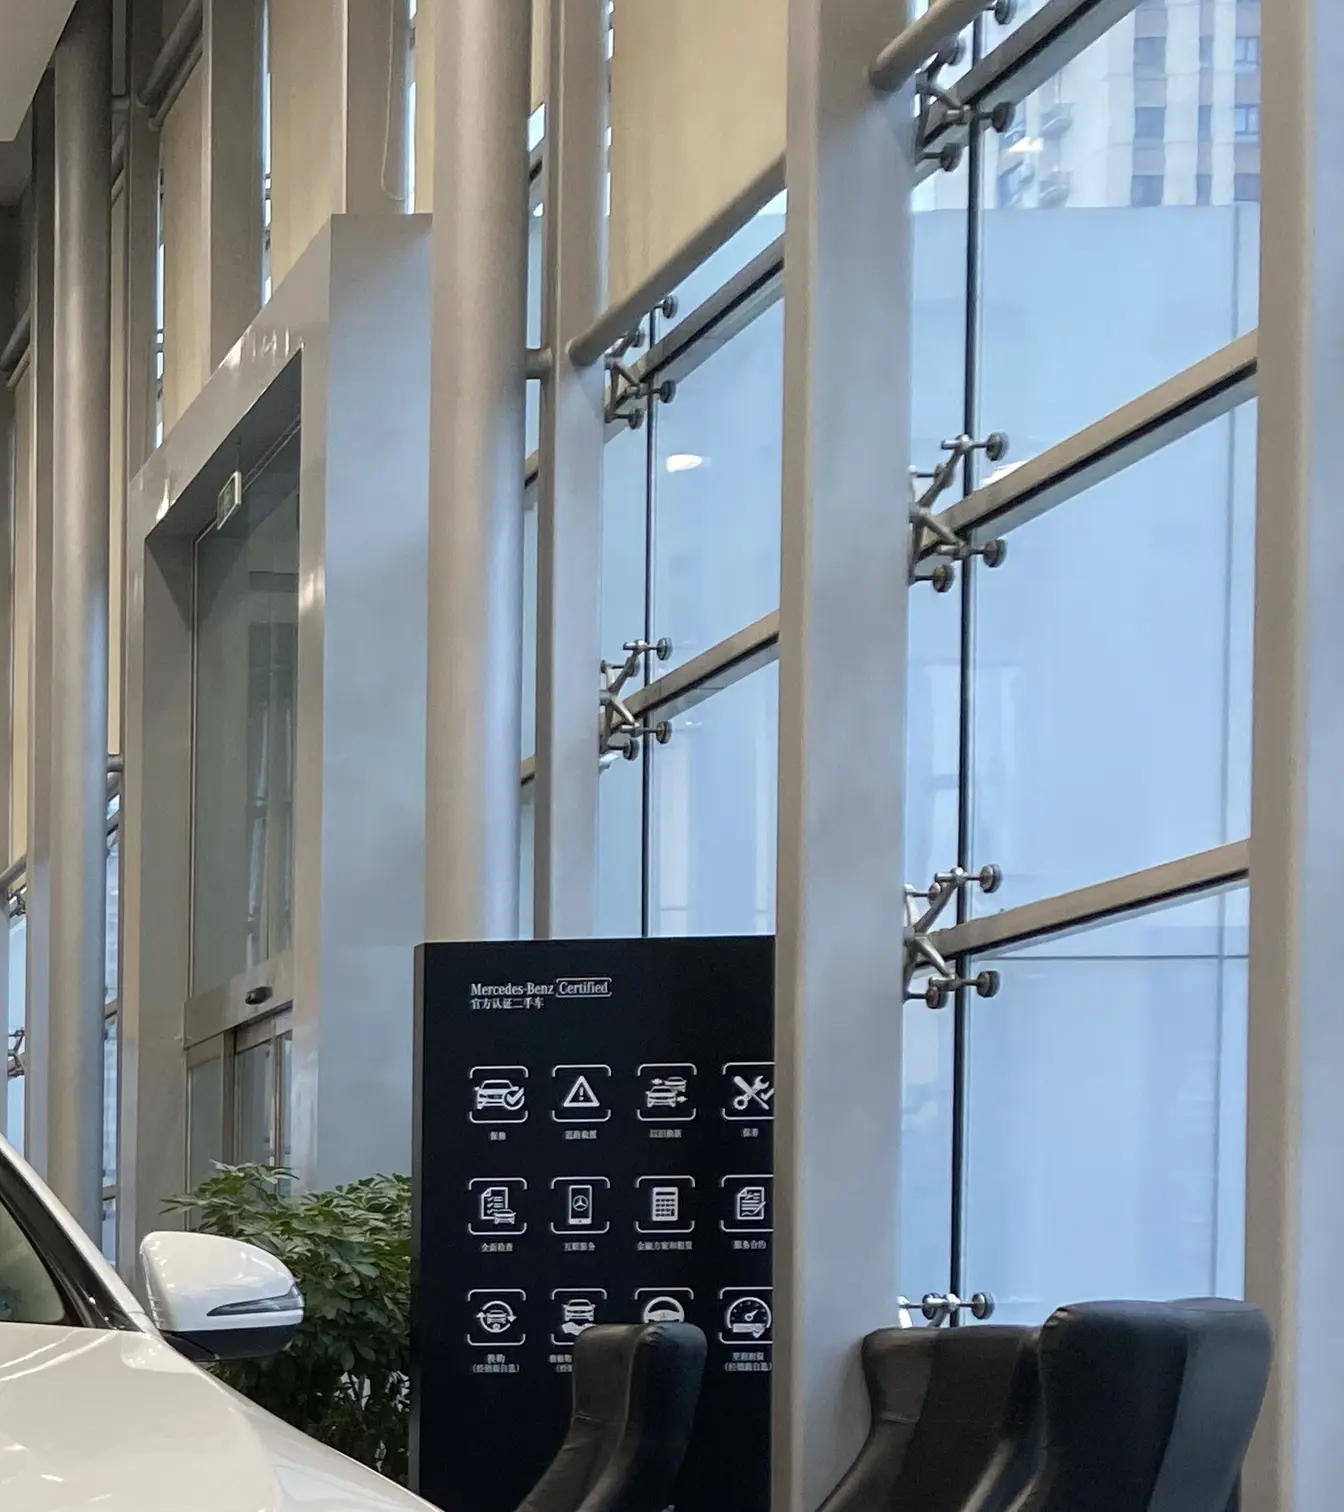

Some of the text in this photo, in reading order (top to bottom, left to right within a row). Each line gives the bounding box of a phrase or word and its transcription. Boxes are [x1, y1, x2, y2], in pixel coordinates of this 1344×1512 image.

[470, 981, 609, 997] Mercedes-Benz Certified
[470, 997, 545, 1010] 官方认证二手车
